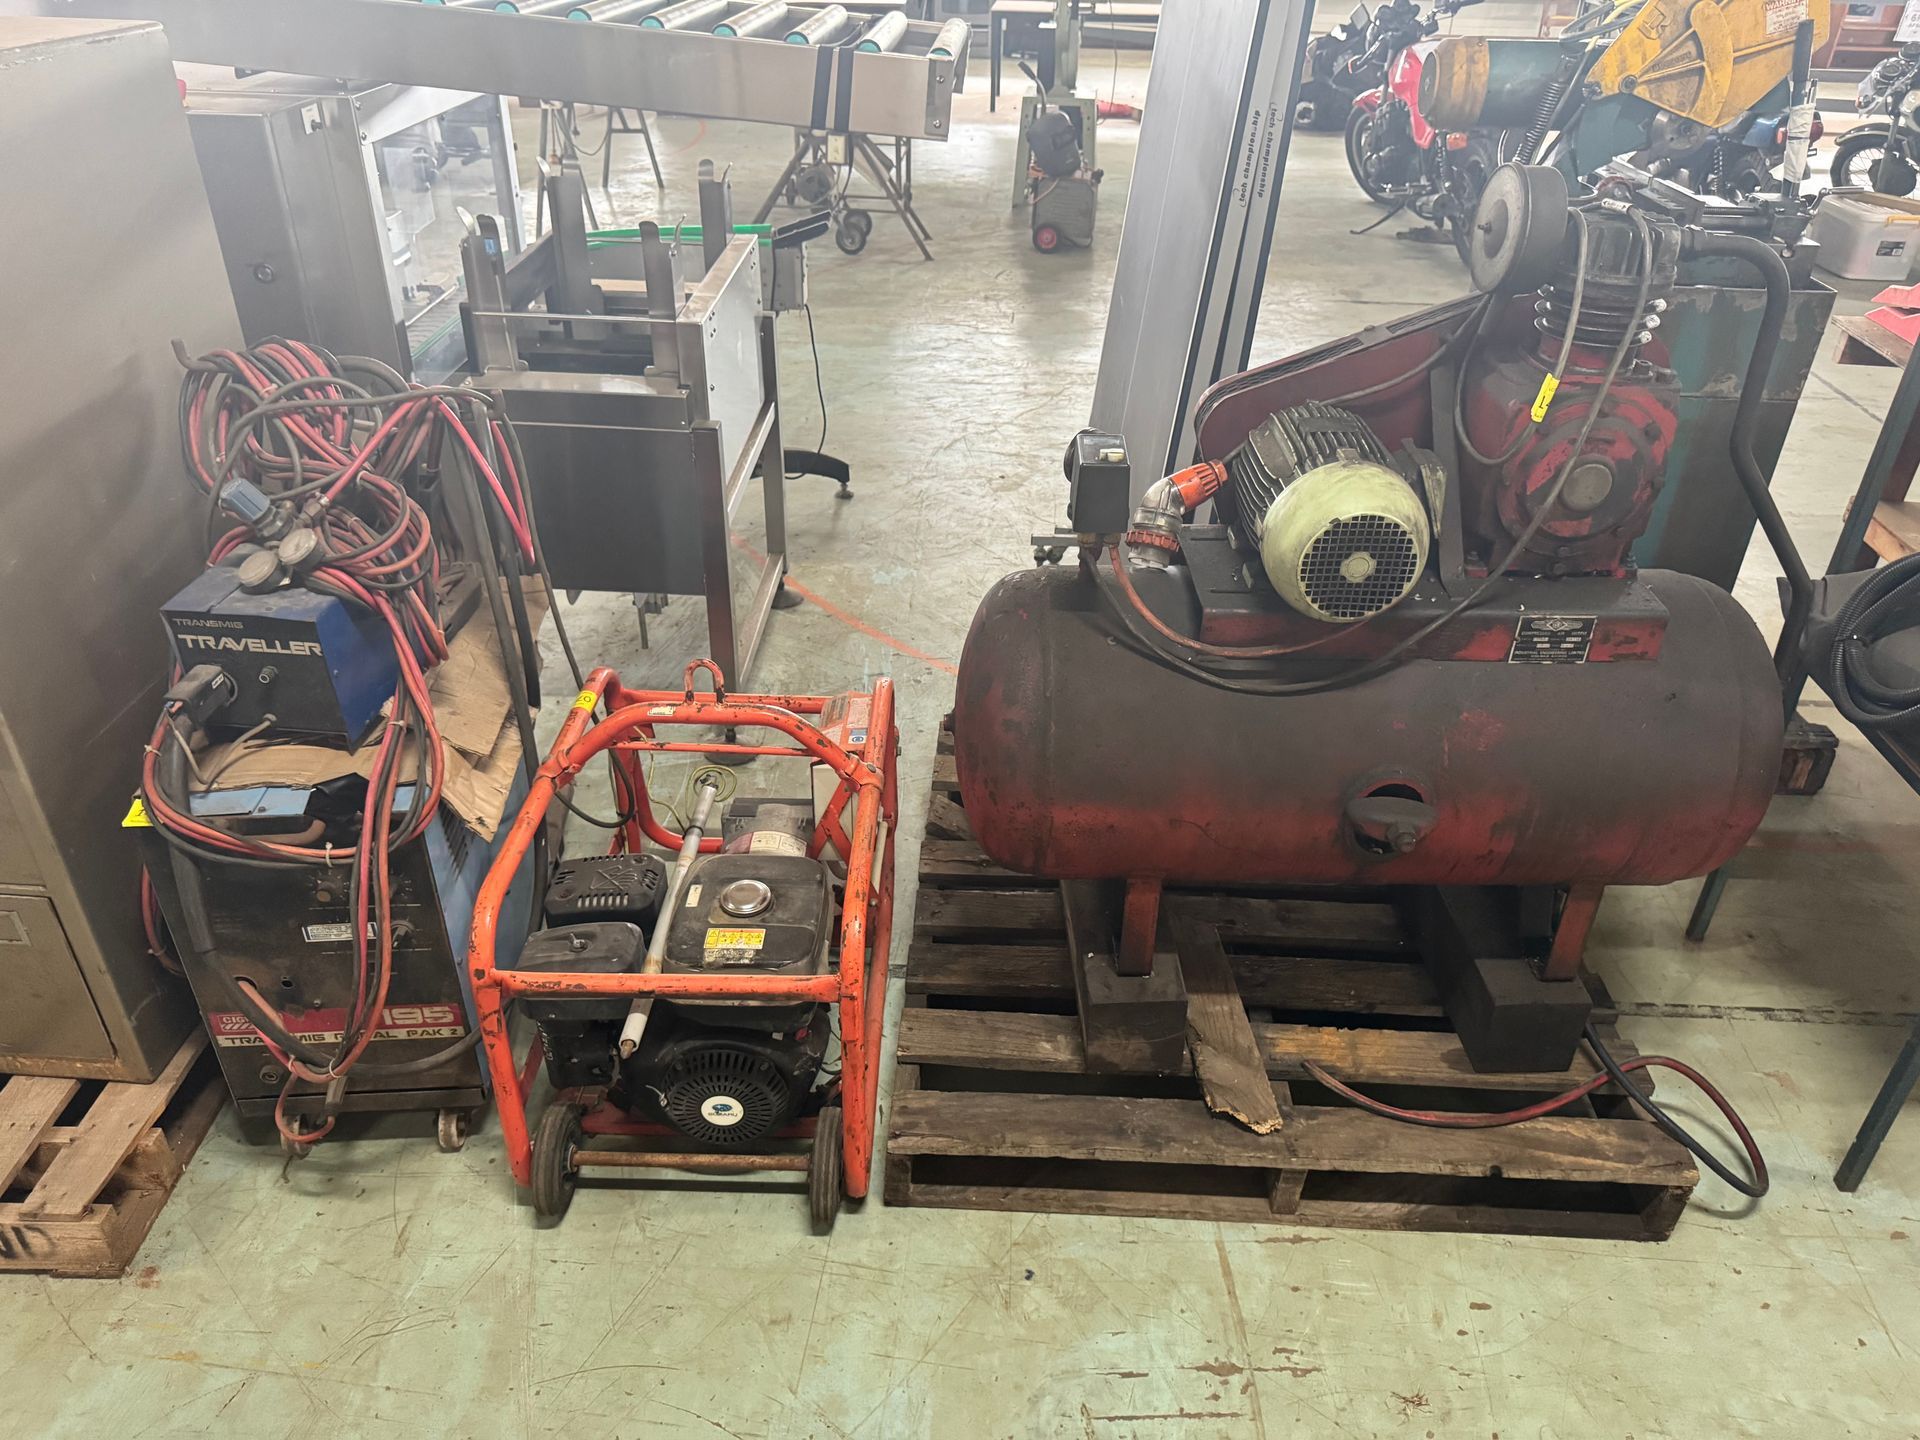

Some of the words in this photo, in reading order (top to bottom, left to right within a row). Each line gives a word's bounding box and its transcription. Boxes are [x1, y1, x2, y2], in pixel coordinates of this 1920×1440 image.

[1765, 0, 1802, 10] WARNIN
[1268, 108, 1277, 128] tech
[1257, 131, 1273, 198] championship
[1239, 182, 1248, 202] tech
[172, 617, 243, 629] TRANSMIG
[178, 634, 323, 656] TRAVELLER
[382, 1005, 454, 1025] 195
[224, 1033, 325, 1045] TRAMIG
[406, 1028, 444, 1037] PAK
[450, 1028, 458, 1036] 2
